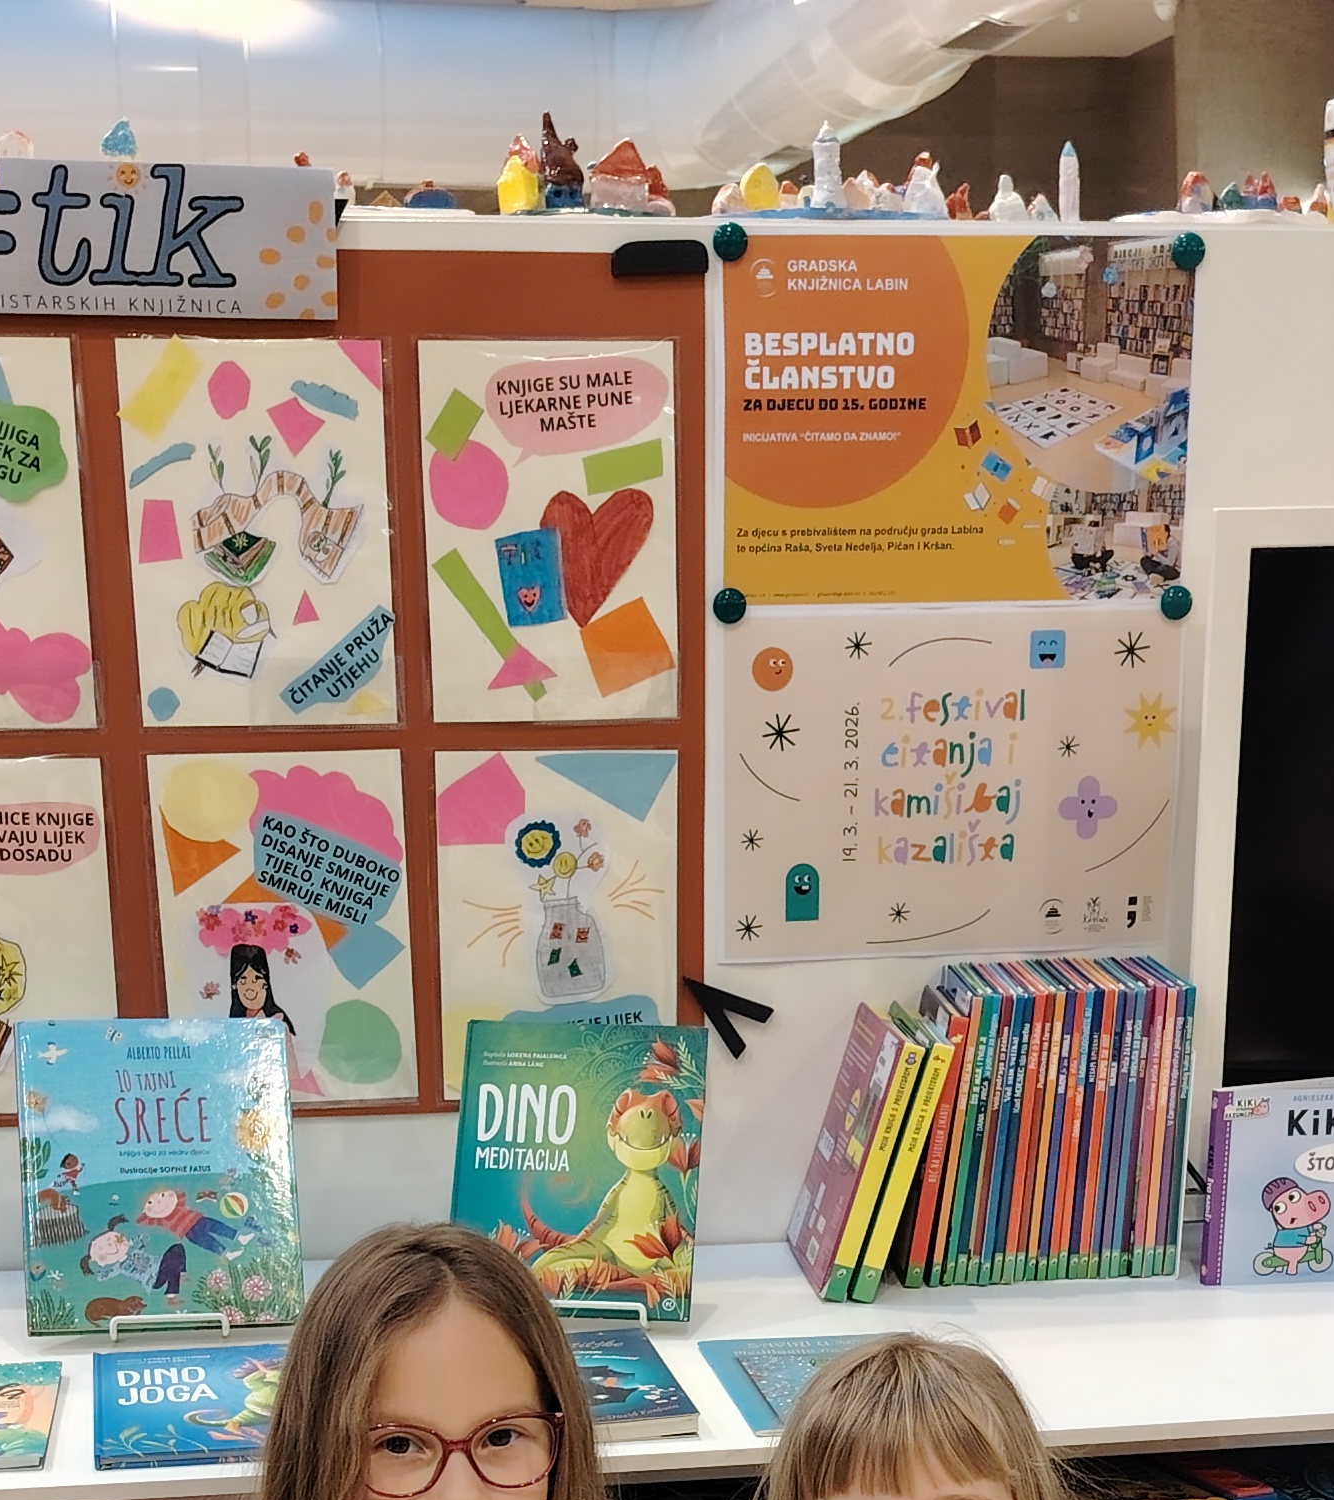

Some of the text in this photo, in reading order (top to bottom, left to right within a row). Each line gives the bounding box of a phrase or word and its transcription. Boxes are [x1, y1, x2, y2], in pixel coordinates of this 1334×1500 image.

[787, 260, 857, 273] GRADSKA
[787, 275, 908, 291] KNJIŽNICA LABIN
[0, 294, 116, 311] ISTARSKIH
[128, 295, 242, 314] KNJIŽNICA
[744, 332, 915, 357] BESPLATNO
[496, 370, 633, 396] KNJIGE SU MALE
[744, 358, 895, 390] ČLANSTVO
[498, 390, 633, 417] LJEKARNE PUNE
[743, 397, 927, 411] ZA DJECU DO 15. GODINE
[540, 408, 597, 433] MAŠTE
[743, 432, 797, 442] INICIJATIVA
[843, 432, 858, 442] DA
[19, 451, 42, 473] ZA
[737, 525, 984, 539] Za djecu prebivalištem na području grada Labina
[748, 542, 782, 554] općina
[785, 542, 812, 554] Raša,
[289, 611, 395, 706] ČITANJE PRUŽA
[326, 648, 381, 700] UTJEHU
[880, 688, 1026, 726] 2. festival
[842, 702, 860, 862] 19. 3. 21. 3. 2026.
[35, 811, 95, 830] KNJIGE
[43, 828, 86, 845] LIJEK
[878, 818, 1015, 866] kazališta
[0, 847, 72, 863] DOSADU
[262, 815, 400, 884] KAO ŠTO DUBOKO
[261, 834, 391, 899] DISANJE SMIRUJE
[263, 852, 375, 910] TIJELO, KNJIGA
[258, 870, 367, 925] SMIRUJE MISLI
[127, 1046, 191, 1060] ALBERTO PELLAI
[115, 1069, 176, 1093] 10 TAJNI
[114, 1088, 212, 1145] SREĆE
[477, 1083, 577, 1145] DINO
[474, 1146, 570, 1172] MEDITACIJA
[117, 1366, 205, 1387] DINO
[118, 1383, 218, 1406] JOGA
